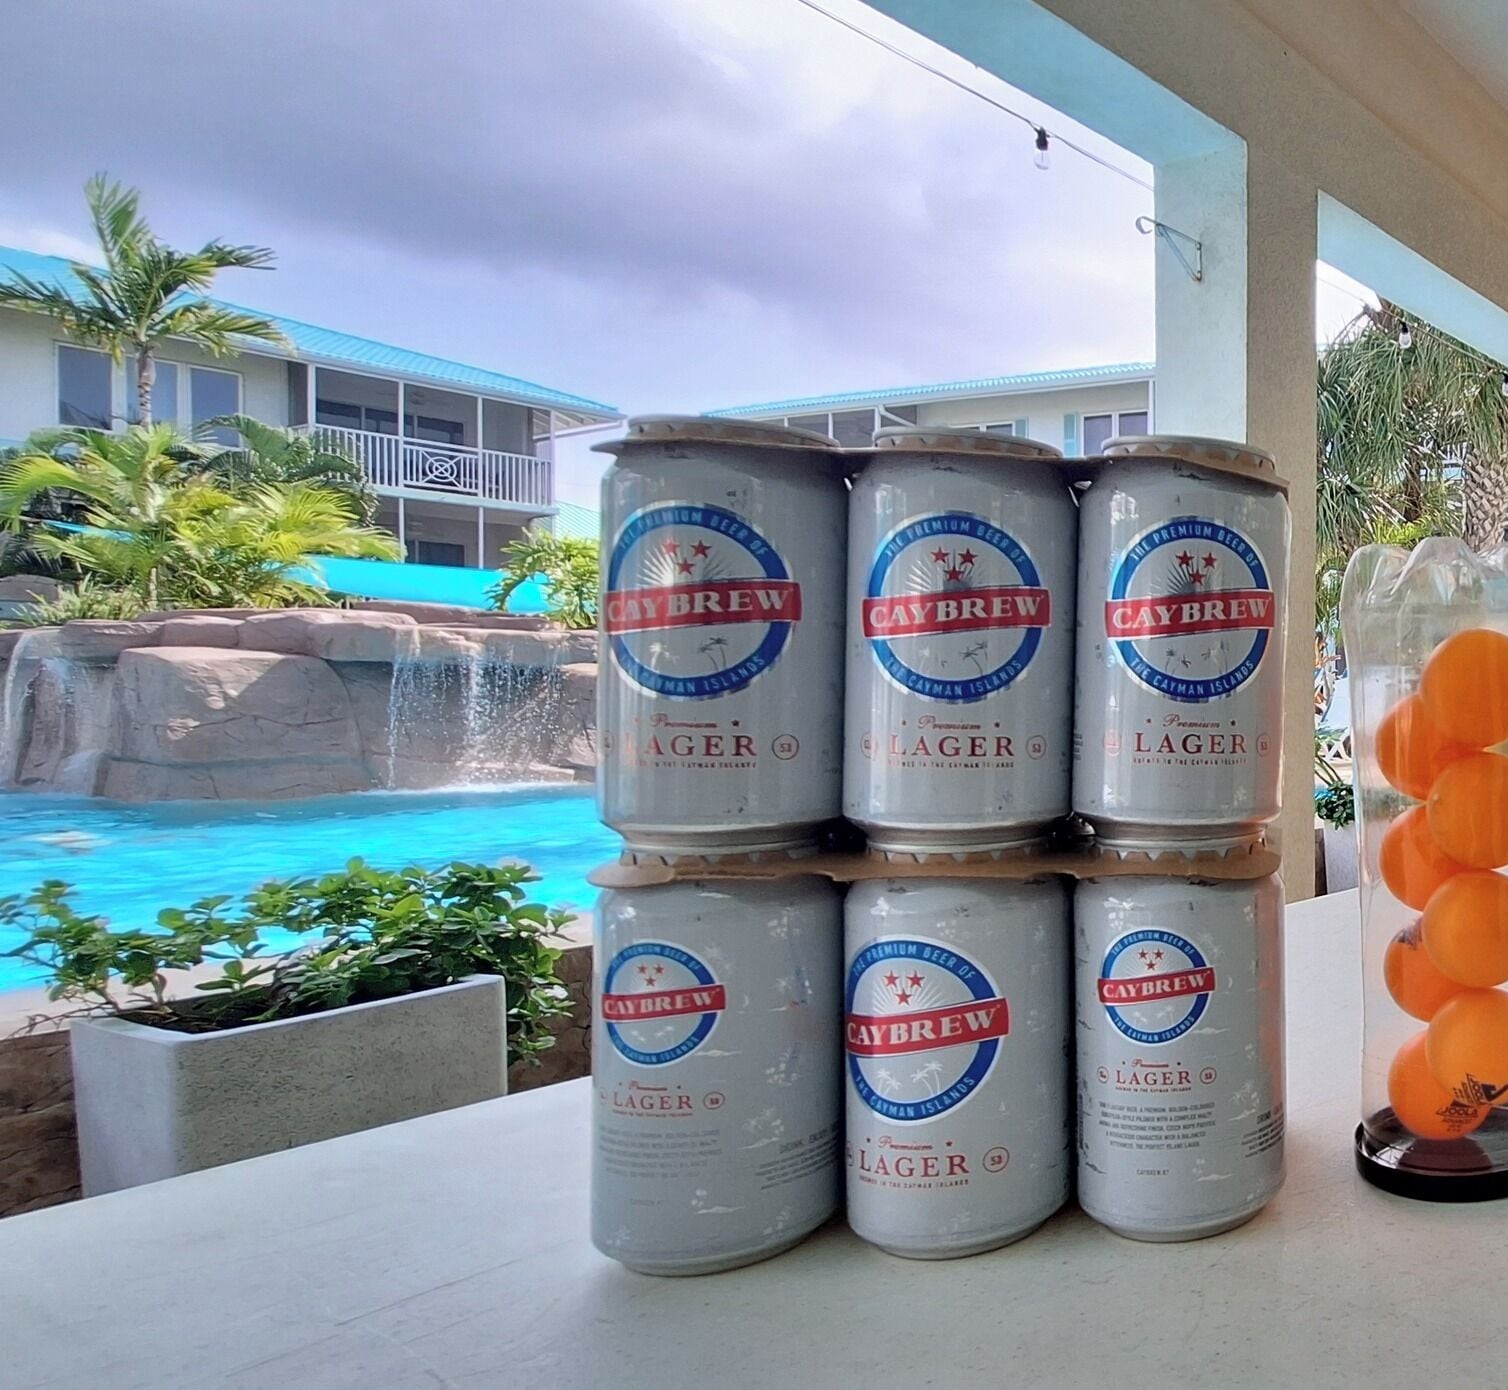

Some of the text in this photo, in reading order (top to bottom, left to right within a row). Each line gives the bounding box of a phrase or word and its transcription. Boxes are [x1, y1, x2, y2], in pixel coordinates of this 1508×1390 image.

[710, 514, 748, 539] BEER
[750, 540, 769, 555] OF
[907, 520, 970, 540] PREMIUM
[977, 525, 1010, 551] BEER
[1010, 547, 1026, 563] OF
[1130, 525, 1260, 567] THE PREMIUM BEER OF
[607, 588, 789, 623] CAYBREW
[869, 595, 1042, 628] CAYBREW
[1112, 597, 1270, 629] CAYBREW
[704, 656, 765, 692] ISLANDS
[885, 657, 1022, 696] THE CAYMAN ISLANDS
[1130, 658, 1254, 695] THE CAYMAN ISLANDS
[1162, 713, 1220, 728] Premium
[625, 733, 757, 757] LAGER
[889, 735, 1014, 757] LAGER
[1135, 732, 1247, 754] LAGER
[866, 943, 917, 960] PREMIUM
[923, 947, 957, 967] BEER
[958, 967, 976, 979] OF
[604, 989, 714, 1015] CAYBREW
[1102, 973, 1208, 998] CAYBREW
[848, 1007, 996, 1047] CAYBREW
[1116, 1070, 1192, 1086] LAGER
[613, 1091, 693, 1110] LAGER
[870, 1097, 915, 1117] CAYMAN
[921, 1077, 976, 1116] ISLANDS
[860, 1149, 970, 1178] LAGER
